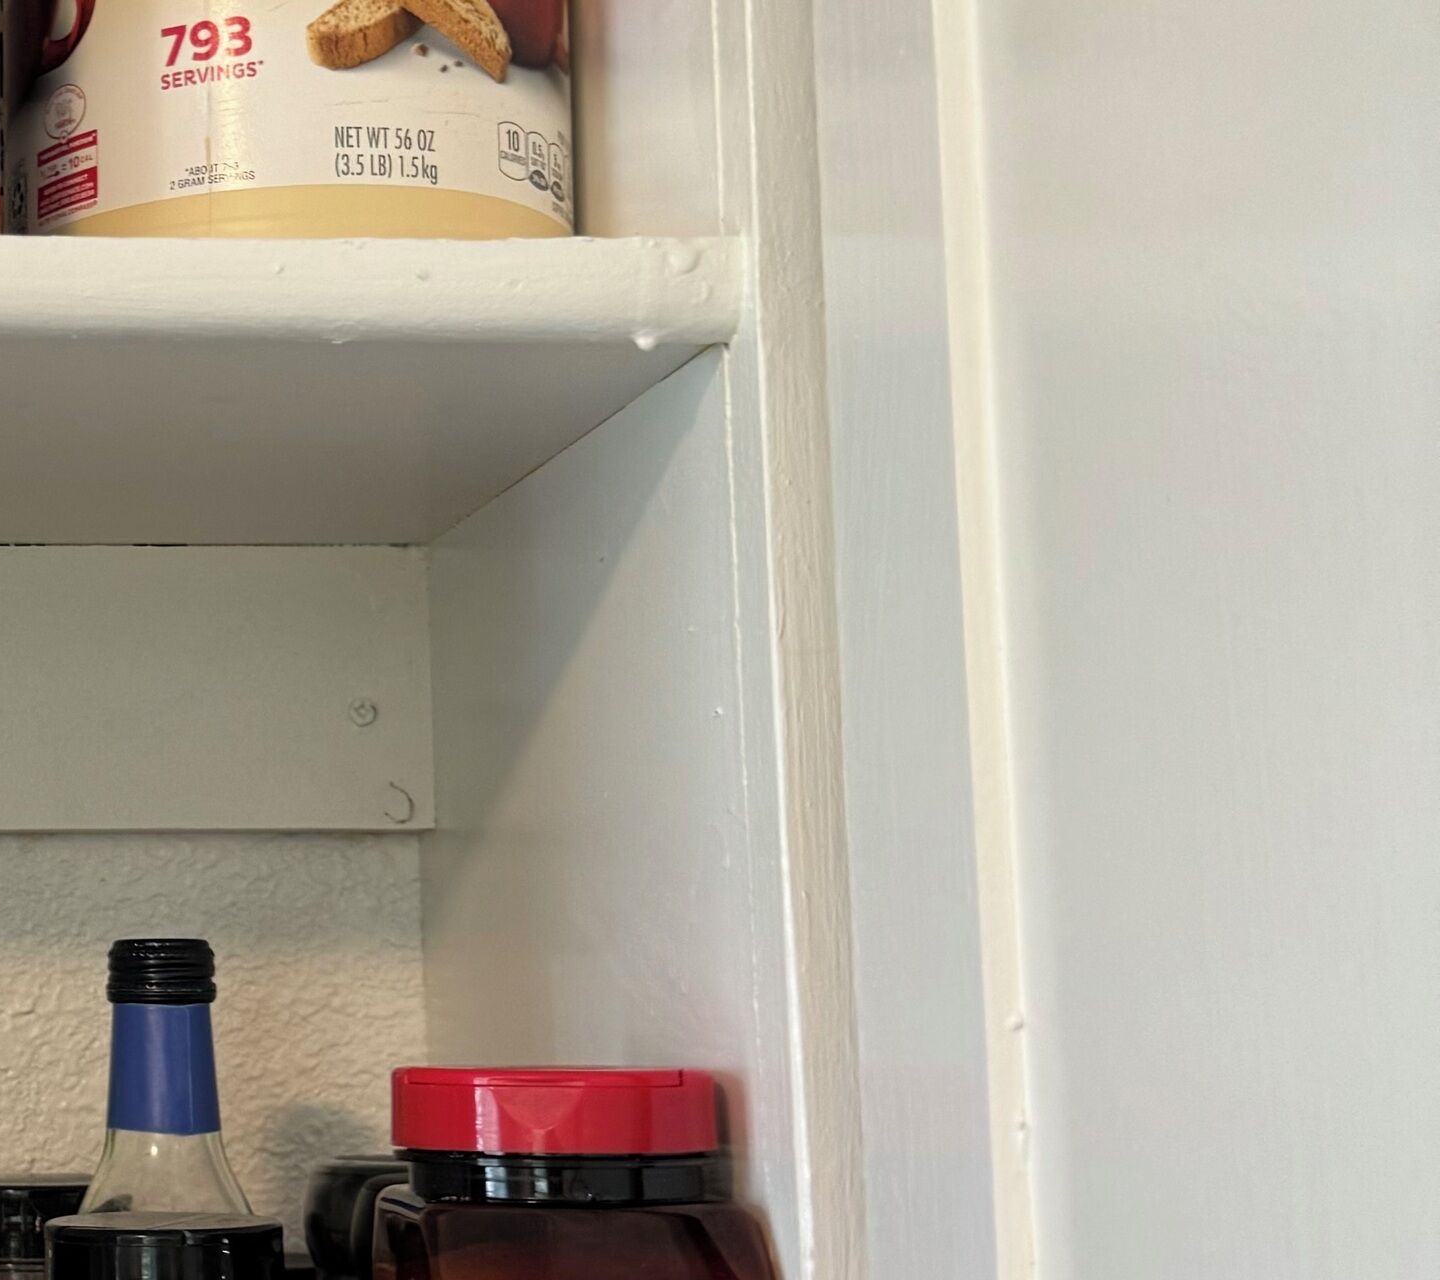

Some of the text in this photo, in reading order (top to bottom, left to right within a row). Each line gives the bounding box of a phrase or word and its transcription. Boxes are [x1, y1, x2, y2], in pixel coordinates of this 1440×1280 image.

[160, 15, 254, 67] 793
[334, 126, 436, 153] NET WT 56 OZ
[505, 128, 520, 152] 10
[335, 152, 392, 179] (3.5 LB)
